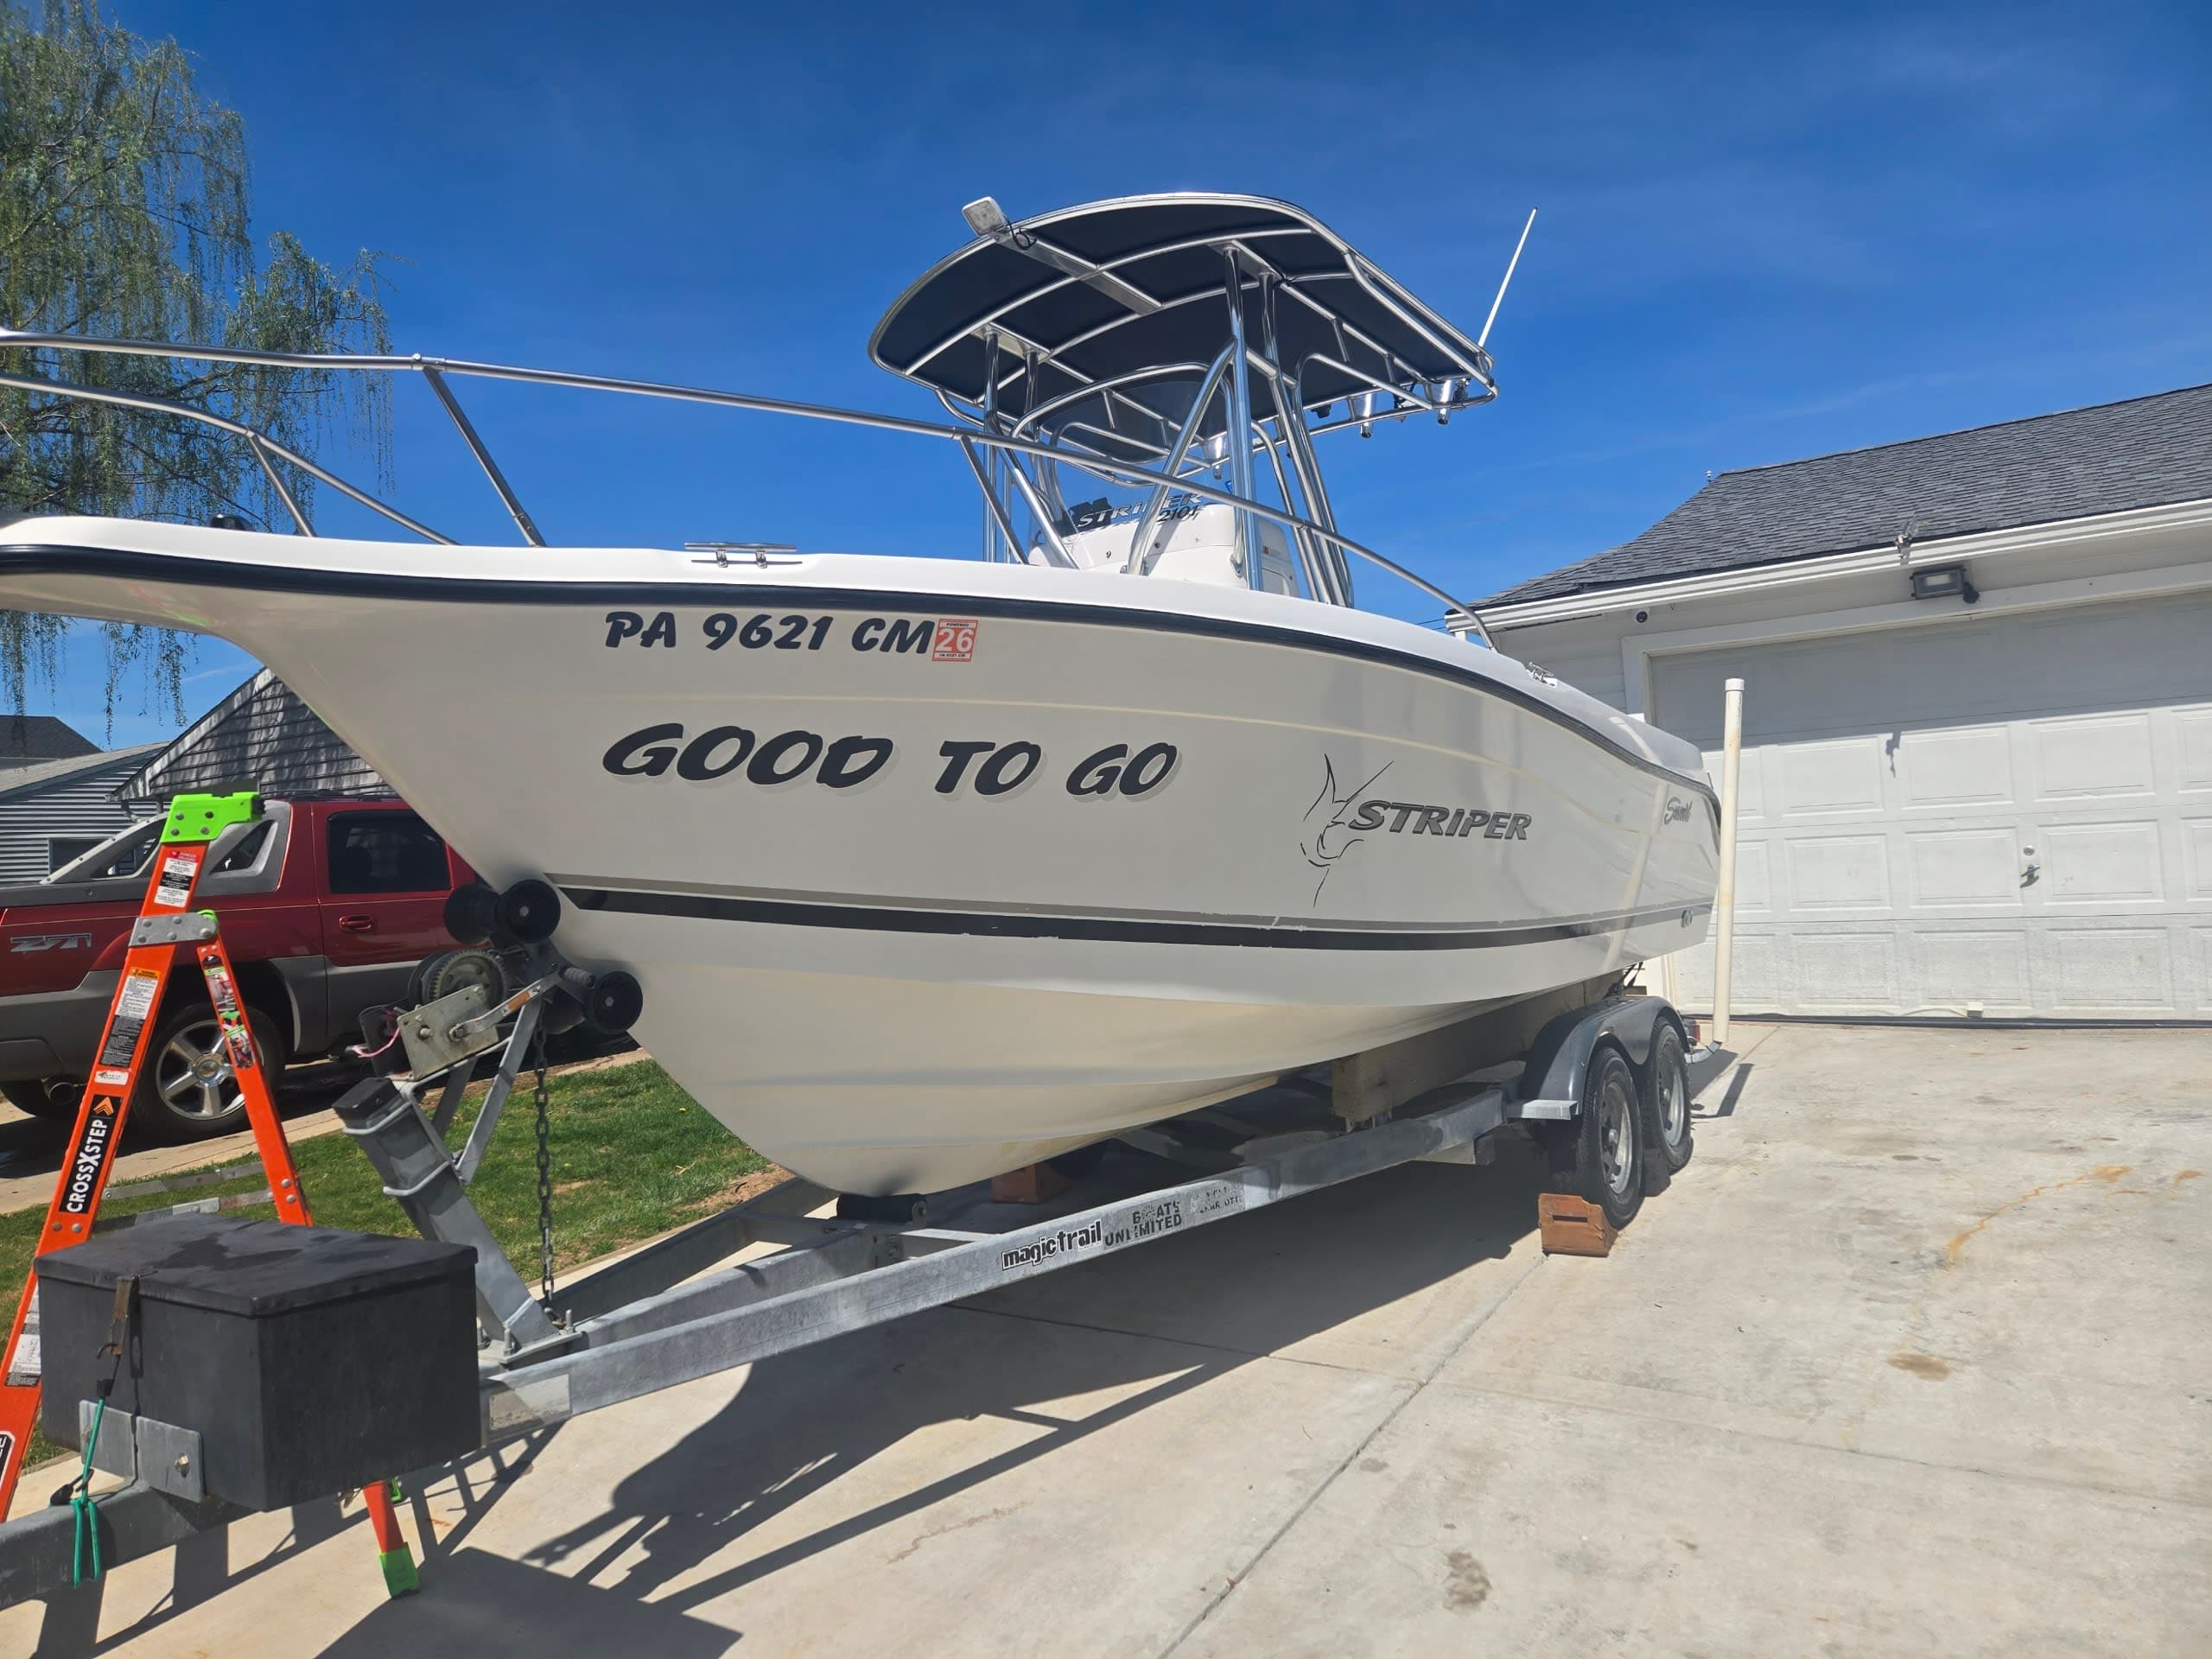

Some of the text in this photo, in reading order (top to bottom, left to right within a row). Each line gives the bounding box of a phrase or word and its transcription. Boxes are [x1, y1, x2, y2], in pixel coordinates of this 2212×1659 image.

[1077, 493, 1203, 528] STRIER
[605, 611, 936, 654] PA 9621 CM
[935, 627, 974, 652] 26
[602, 722, 1182, 801] GOOD TO GO
[1348, 799, 1533, 841] STRIPER
[10, 932, 92, 953] Z71
[66, 1118, 109, 1213] CROSSXSTEP
